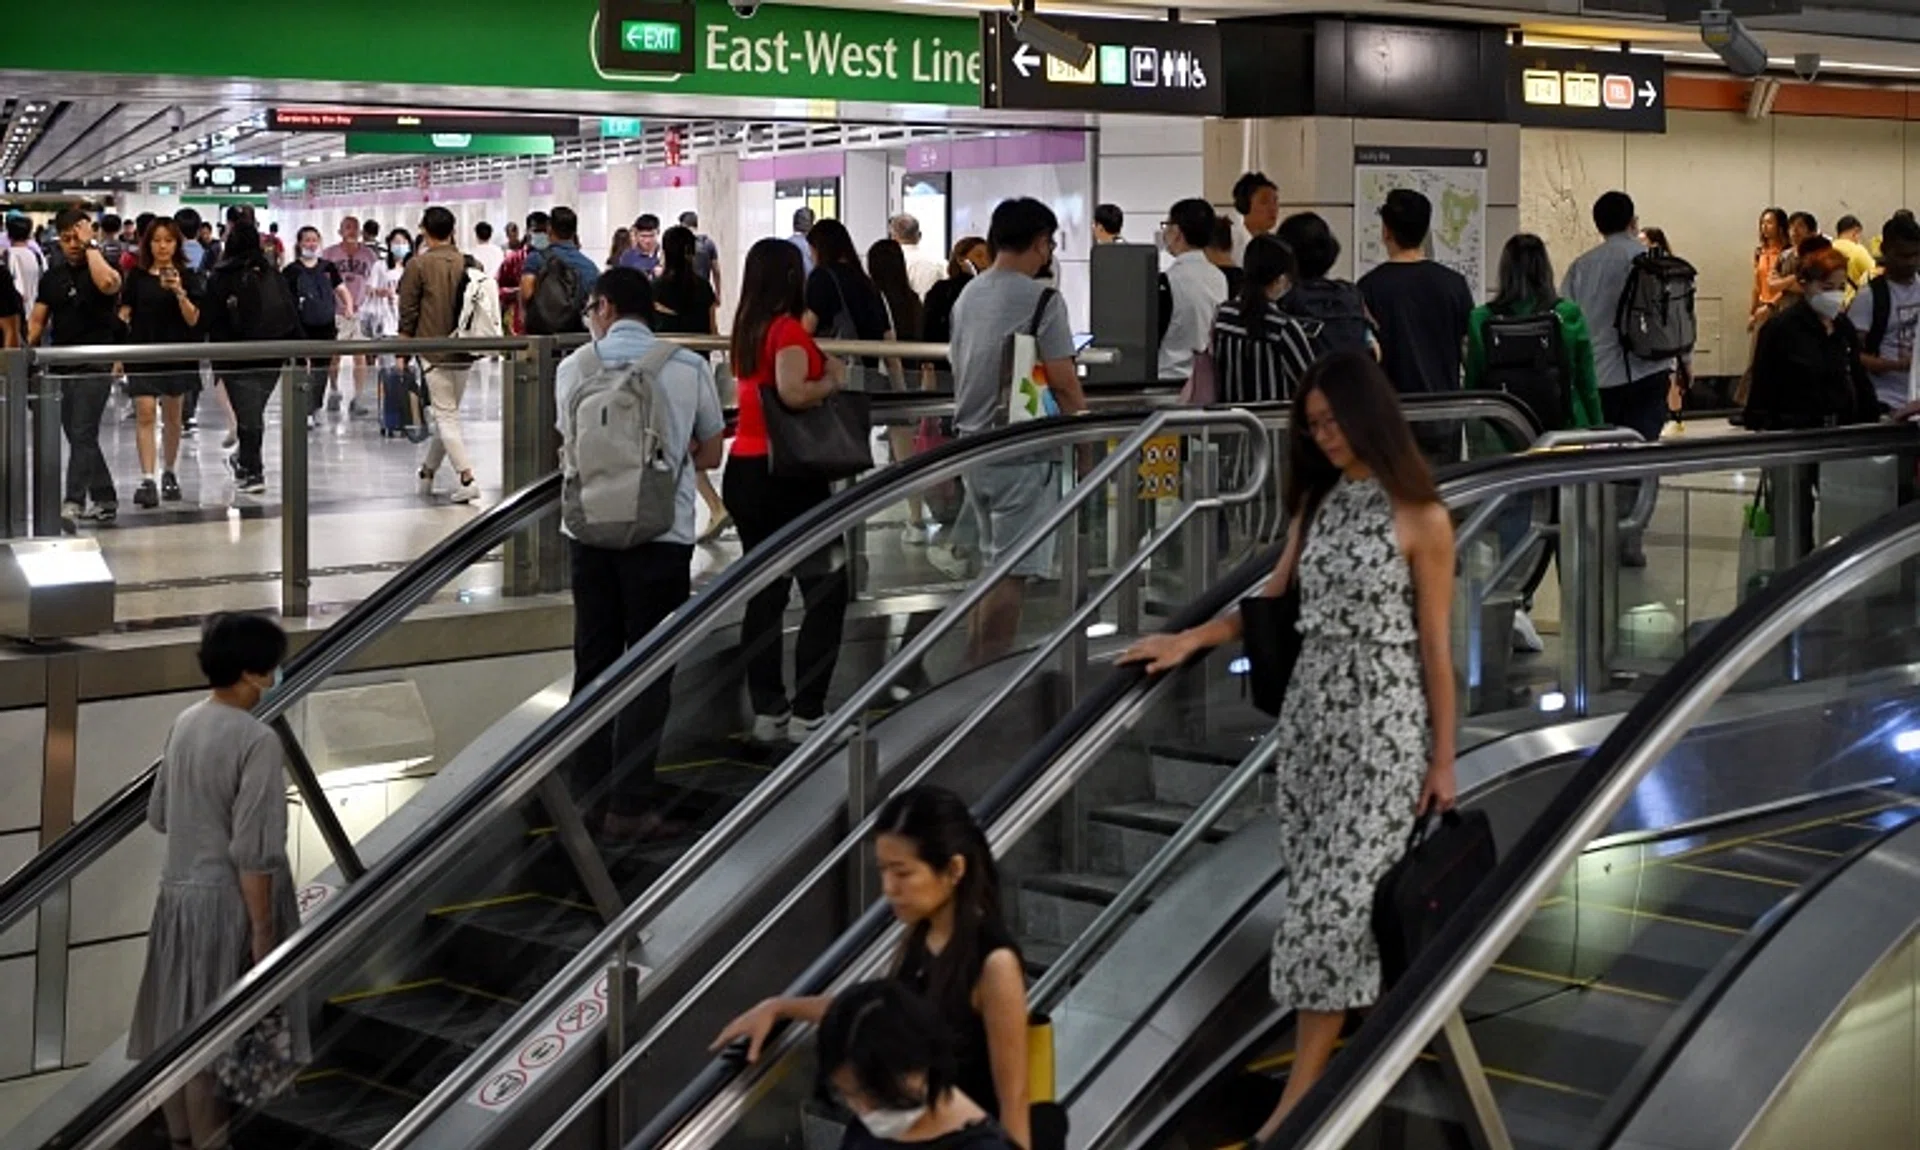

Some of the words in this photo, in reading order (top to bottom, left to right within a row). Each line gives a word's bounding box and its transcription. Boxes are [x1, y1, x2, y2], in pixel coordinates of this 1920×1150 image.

[644, 25, 676, 50] EXIT
[706, 24, 899, 79] East-West
[912, 37, 981, 84] Line
